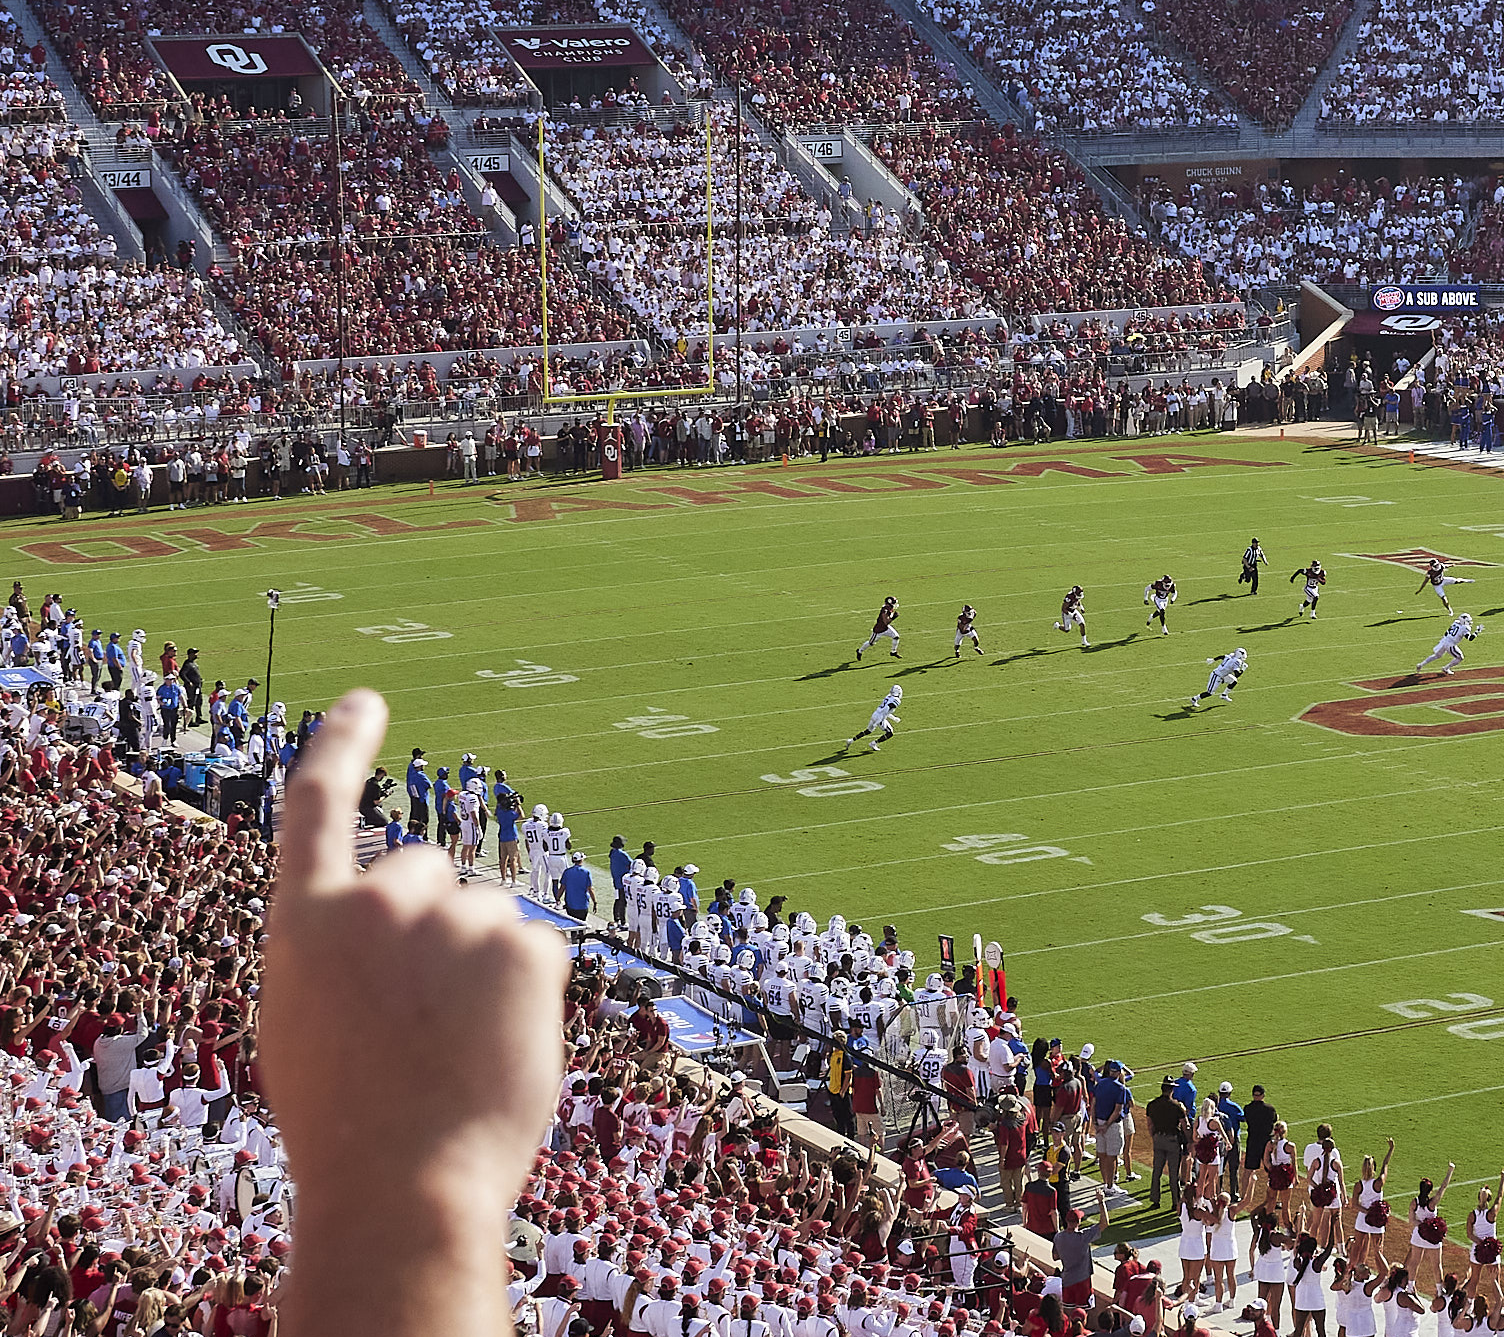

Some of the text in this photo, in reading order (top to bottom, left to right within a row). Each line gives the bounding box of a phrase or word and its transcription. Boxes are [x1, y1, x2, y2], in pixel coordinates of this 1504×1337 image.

[550, 37, 630, 49] Valero
[206, 44, 267, 74] OU
[533, 48, 623, 59] CHAMPIONS
[1406, 291, 1414, 305] A
[1417, 291, 1438, 305] SUB
